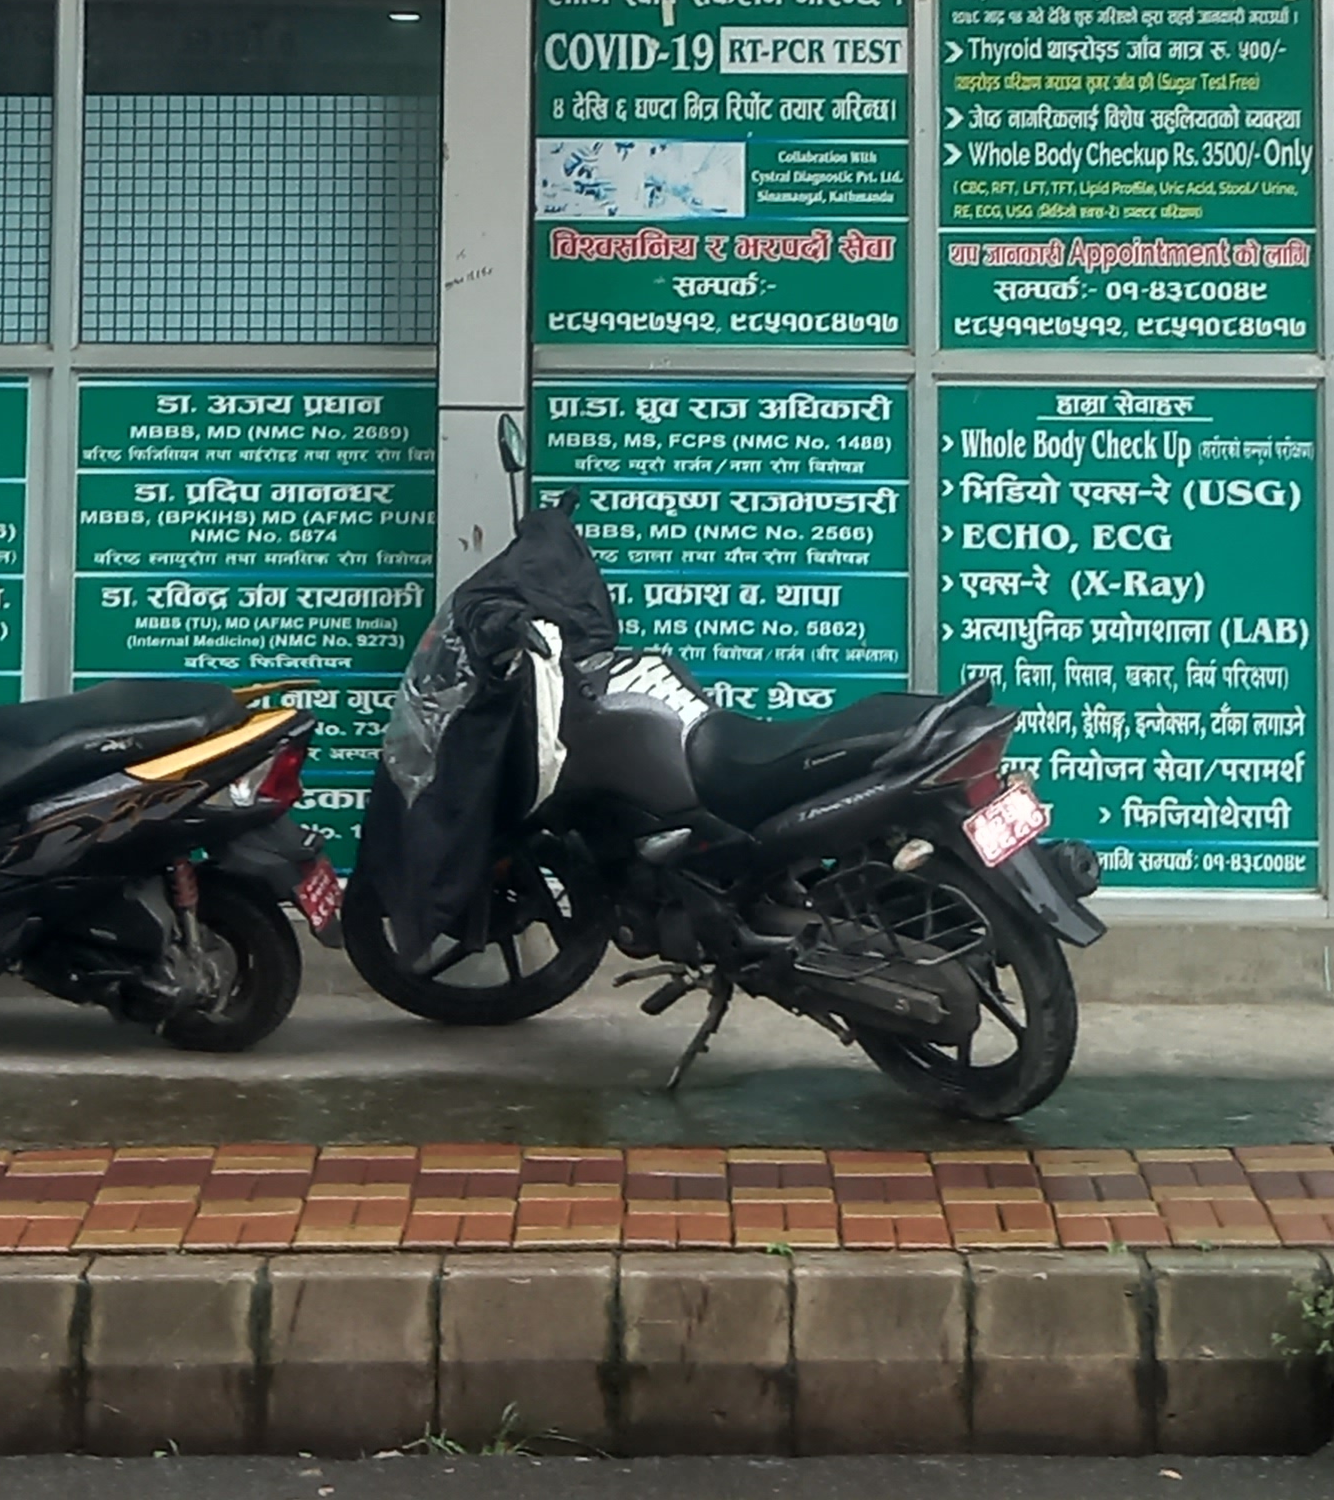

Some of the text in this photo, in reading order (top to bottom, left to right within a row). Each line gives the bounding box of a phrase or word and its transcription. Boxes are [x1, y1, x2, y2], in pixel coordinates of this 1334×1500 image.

[544, 33, 903, 71] COVID-19 RT-PCR TEST
[967, 36, 1043, 66] Thyroid
[1047, 35, 1121, 63] थाइरोइड
[1168, 40, 1205, 61] मात्र
[1209, 40, 1231, 61] रु.
[1238, 38, 1287, 63] ५००/-
[572, 90, 610, 121] देखि
[634, 98, 678, 120] घण्टा
[684, 90, 720, 122] भित्र
[779, 98, 826, 122] तयार
[968, 102, 1302, 135] जेष्ठ नागरिकलाई विशेष सहुलियतको व्यवस्था
[968, 137, 1314, 175] Whole Body Checkup Rs. 3500/- Only
[953, 204, 1034, 220] RE, ECG, USG
[156, 394, 384, 417] डा. अजय प्रधान
[548, 397, 625, 420] प्रा.डा.
[688, 398, 750, 420] राज
[758, 392, 893, 421] अधिकारी
[1113, 389, 1195, 416] सेवाहरू
[548, 432, 618, 450] MBBS,
[624, 433, 662, 450] MS,
[669, 433, 727, 449] FCPS
[732, 434, 789, 452] (NMC
[795, 434, 830, 450] No.
[960, 428, 1192, 468] Whole Body Check Up
[590, 486, 900, 517] रामकृष्ण राजभण्डारी
[959, 471, 1301, 512] भिडियो एक्स-रे (USG)
[962, 523, 1172, 554] ECHO, ECG
[959, 563, 1205, 604] एक्स-रे (X-Ray)
[960, 609, 1310, 650] अत्याधुनिक प्रयोगशाला (LAB)
[1048, 748, 1306, 783] नियोजन सेवा/परामर्श
[1121, 795, 1292, 830] फिजियोथेरापी
